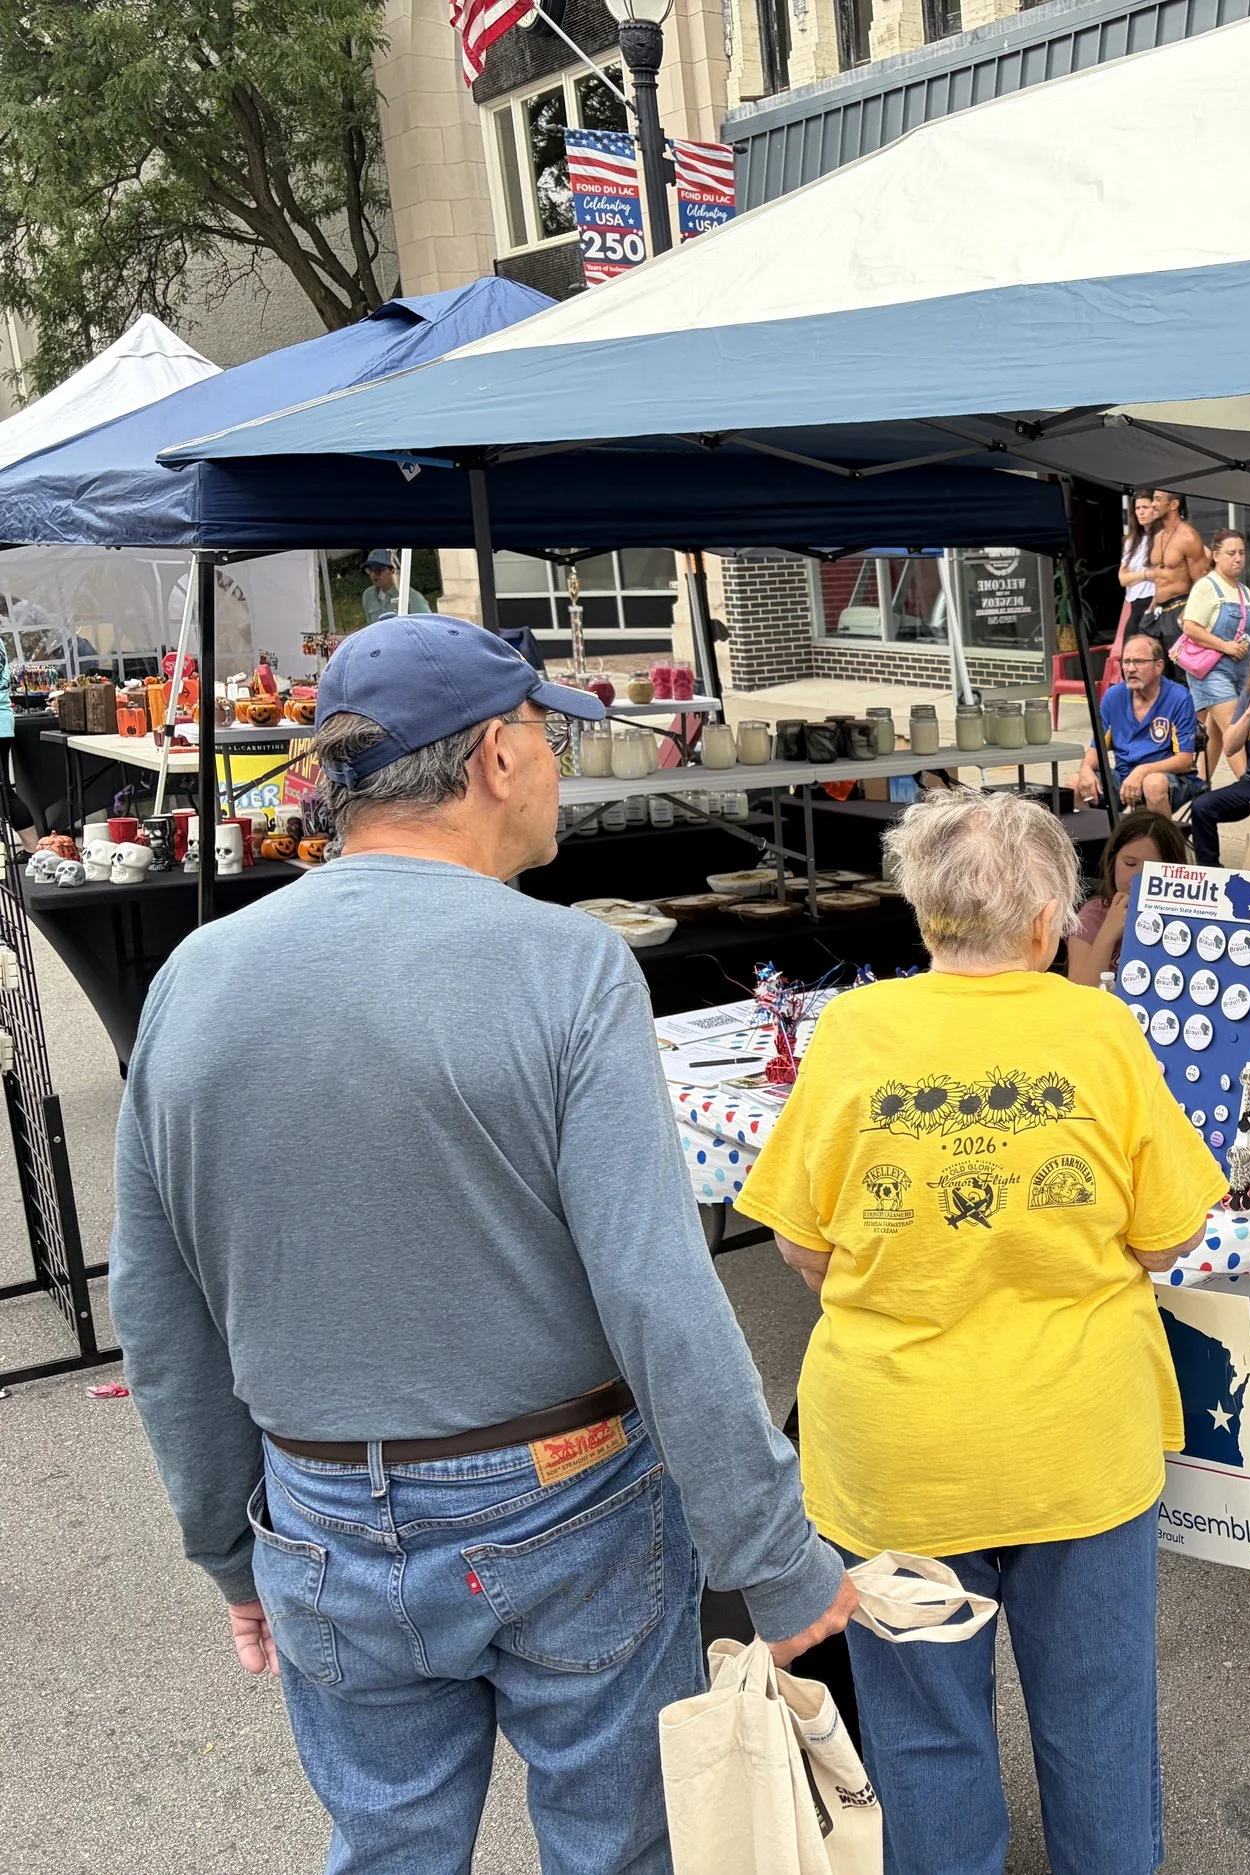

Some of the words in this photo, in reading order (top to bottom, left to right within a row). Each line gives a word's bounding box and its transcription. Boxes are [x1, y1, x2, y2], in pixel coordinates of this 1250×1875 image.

[576, 183, 601, 193] FOND
[603, 185, 617, 195] DU
[618, 187, 635, 196] LAC
[681, 190, 701, 201] FOND
[702, 193, 715, 203] DU
[716, 195, 731, 204] LAC
[583, 196, 631, 215] Celebrating
[595, 213, 624, 227] USA
[686, 204, 728, 222] Celebrating
[695, 220, 719, 232] USA
[582, 230, 645, 262] 250
[586, 263, 602, 272] Years
[602, 264, 609, 272] of
[165, 660, 189, 671] STP
[1161, 865, 1207, 882] Tiffany
[1147, 875, 1219, 902] Brault
[1153, 904, 1179, 912] Wisconsin
[1193, 908, 1218, 917] Assembly
[1124, 975, 1140, 983] Brault
[953, 1136, 996, 1156] 2026
[870, 1166, 903, 1180] KELLEY
[949, 1165, 966, 1175] OLD
[967, 1164, 996, 1173] GLORY
[1033, 1158, 1059, 1186] KELLEY'S
[1061, 1157, 1093, 1183] FARMSTEAD
[926, 1175, 974, 1189] Honor
[977, 1173, 1021, 1188] Flight
[883, 1219, 914, 1227] FARMSTEAD
[561, 1454, 588, 1471] STRAIGHT
